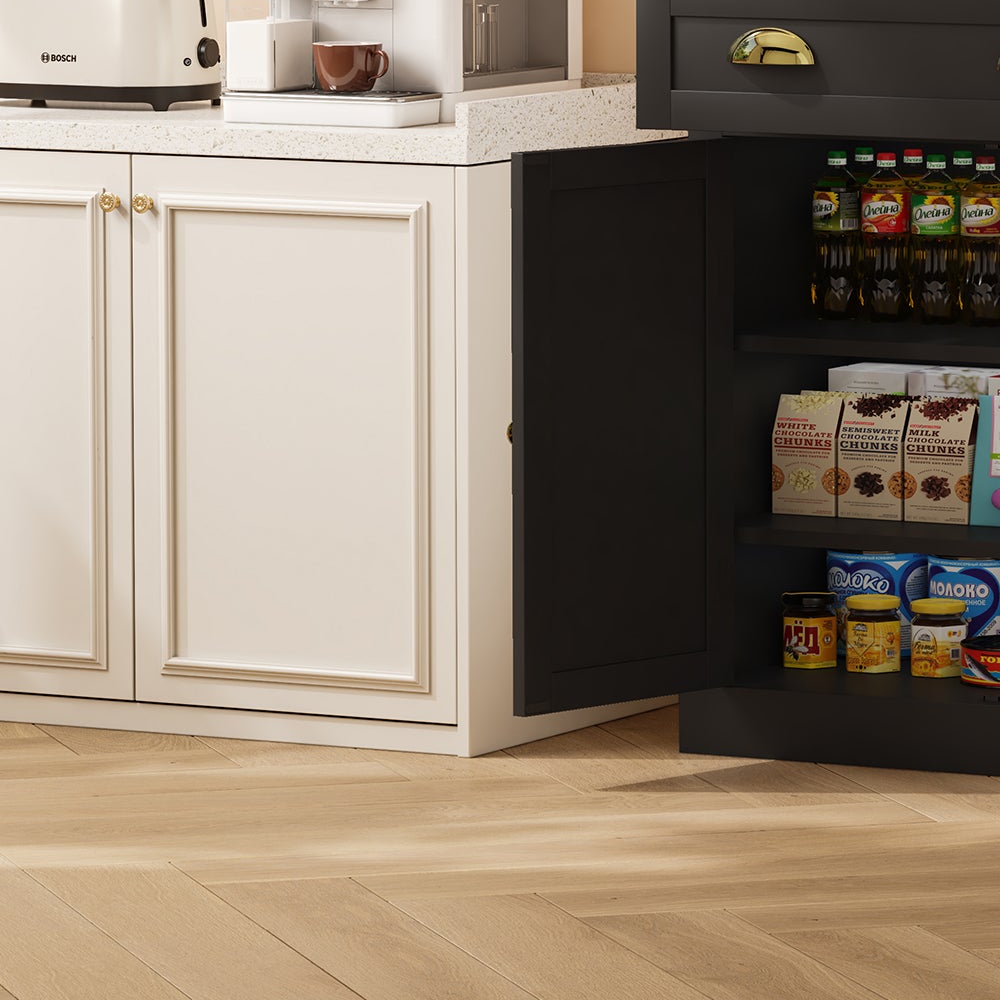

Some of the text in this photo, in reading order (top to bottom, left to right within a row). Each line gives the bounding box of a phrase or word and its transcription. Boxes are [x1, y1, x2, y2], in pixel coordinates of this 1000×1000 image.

[51, 54, 77, 62] BOSCH
[813, 202, 833, 213] ейна
[864, 204, 899, 218] Олейна
[915, 208, 951, 221] Олейна
[776, 422, 817, 431] WHITE
[842, 426, 901, 435] SEMISWEET
[775, 430, 833, 439] CHOCOLATE
[908, 429, 941, 437] MILK
[774, 437, 832, 448] CHUNKS
[841, 434, 899, 442] CHOCOLATE
[907, 437, 967, 446] CHOCOLATE
[840, 441, 898, 451] CHUNKS
[906, 444, 966, 455] CHUNKS
[930, 578, 989, 598] МОЛОКО
